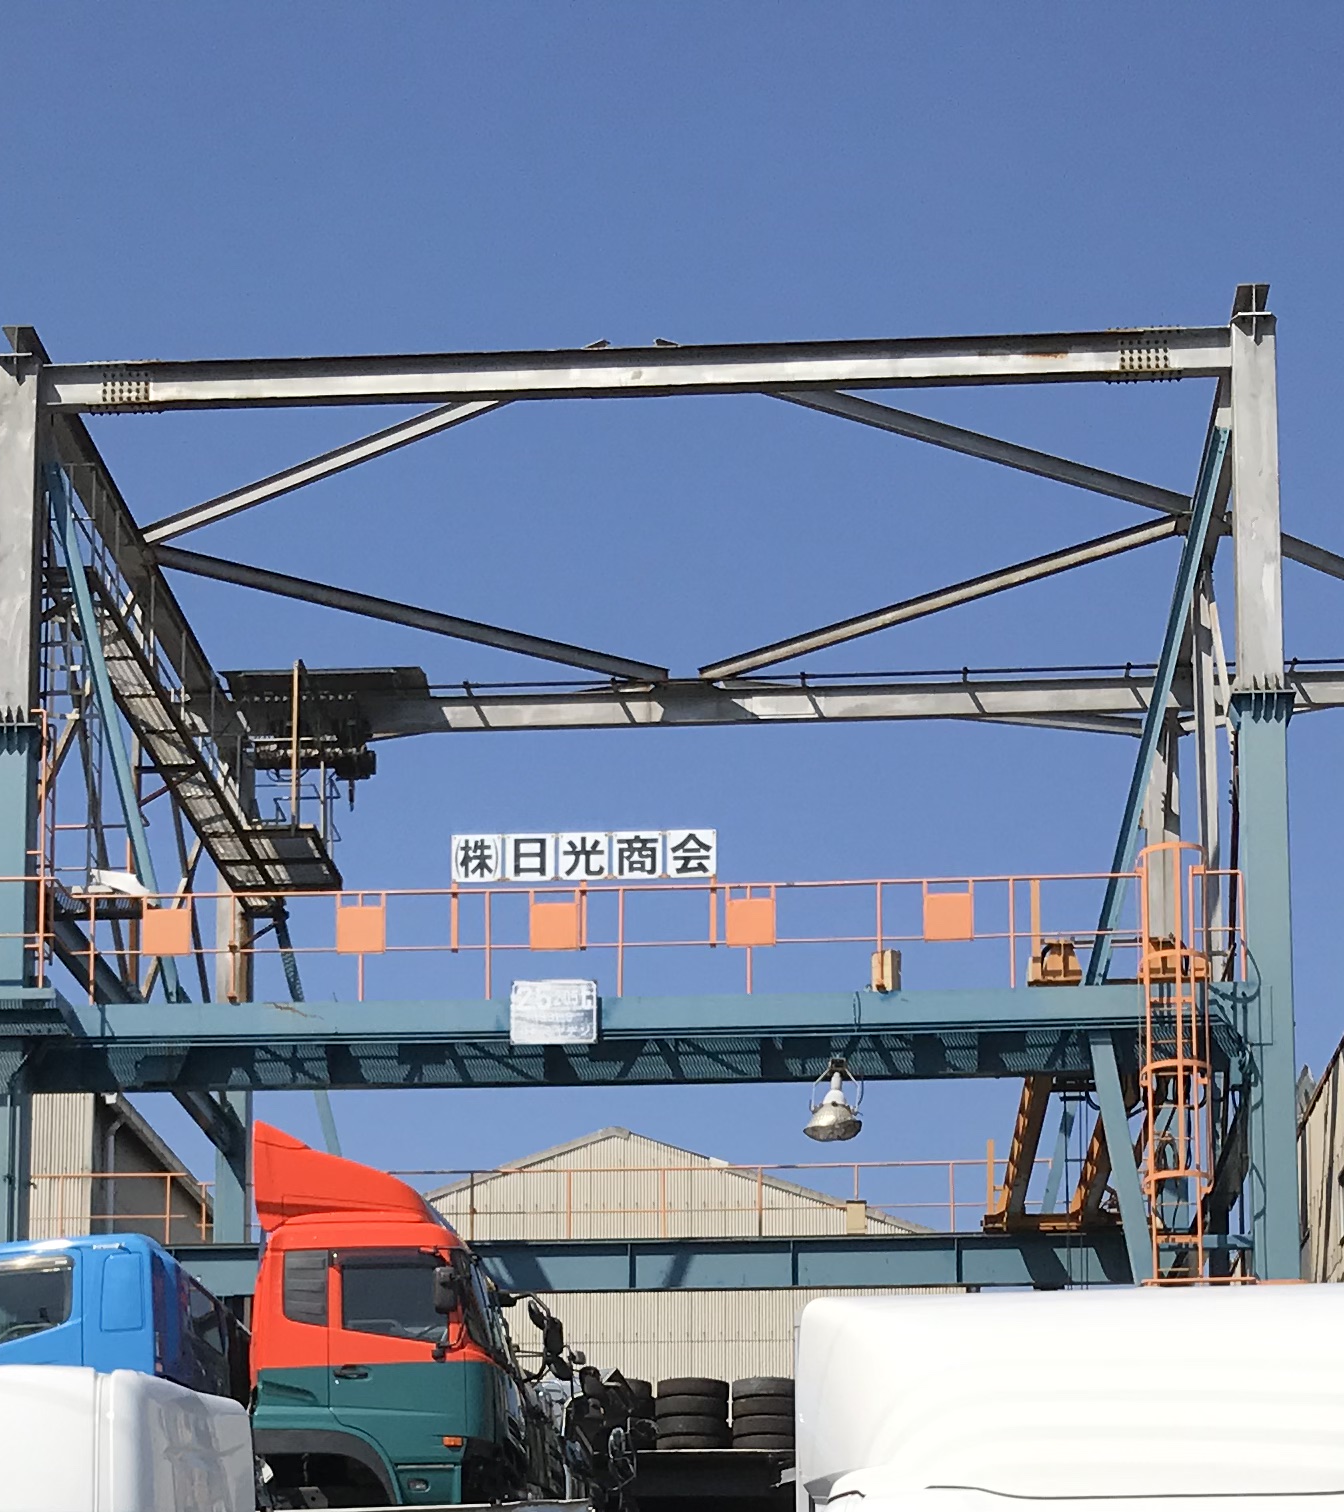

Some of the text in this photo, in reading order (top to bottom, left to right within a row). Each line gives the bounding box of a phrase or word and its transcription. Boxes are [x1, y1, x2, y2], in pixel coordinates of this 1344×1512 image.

[455, 832, 713, 878] (株)日光商会
